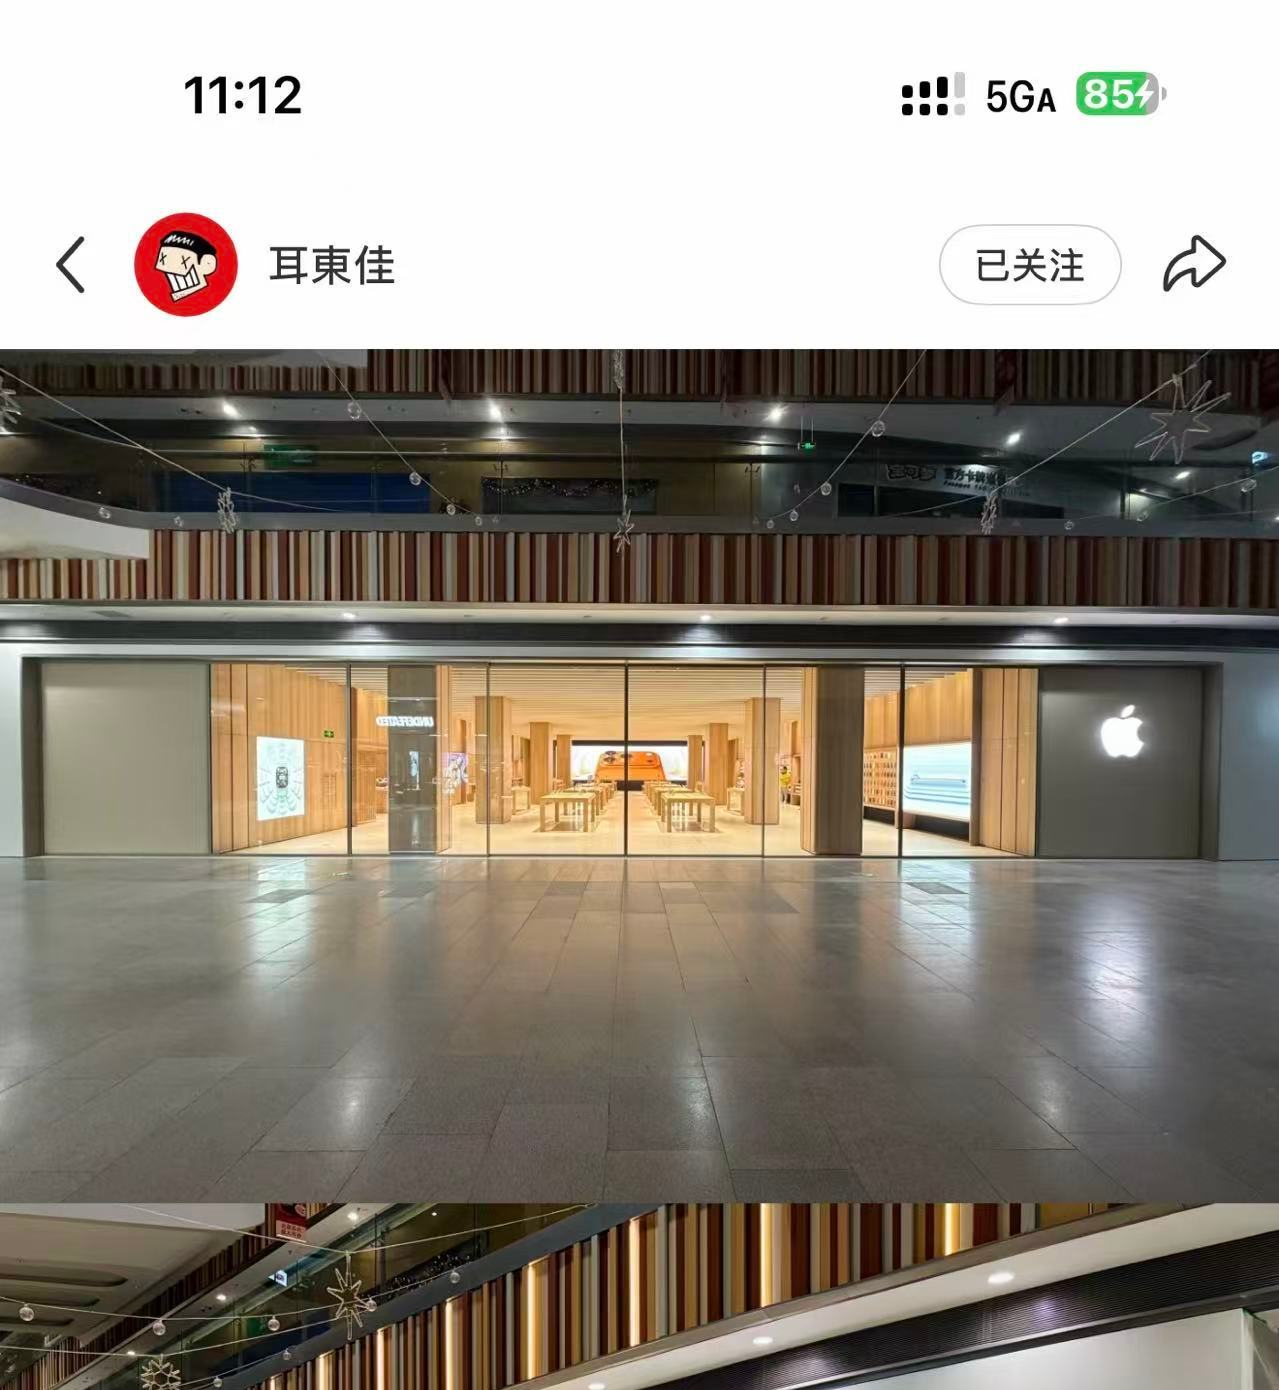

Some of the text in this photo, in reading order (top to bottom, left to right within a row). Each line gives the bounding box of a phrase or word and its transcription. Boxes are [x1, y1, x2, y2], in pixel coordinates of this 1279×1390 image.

[184, 75, 302, 115] 11:12
[1084, 78, 1135, 109] 85
[269, 244, 395, 286] 耳東佳
[976, 247, 1085, 283] 已关注
